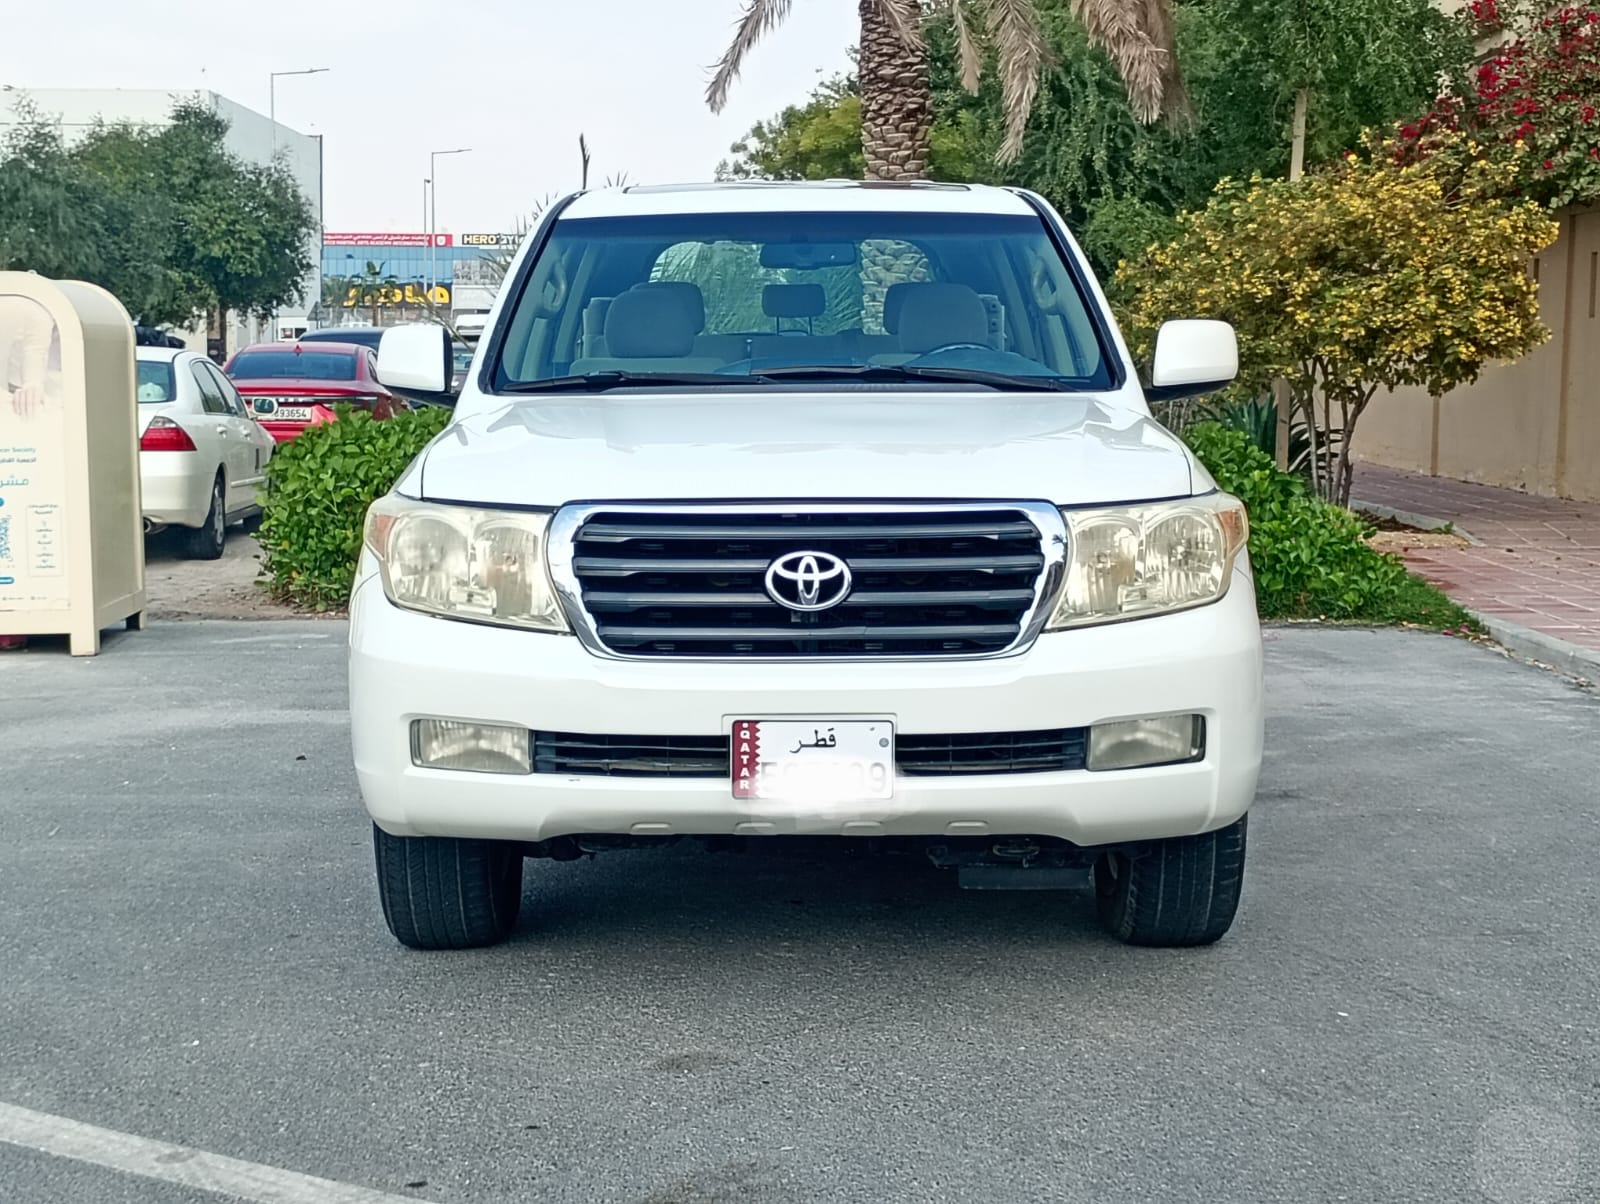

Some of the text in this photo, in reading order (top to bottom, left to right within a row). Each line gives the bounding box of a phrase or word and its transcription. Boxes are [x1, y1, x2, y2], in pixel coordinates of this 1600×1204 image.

[463, 234, 497, 244] HERO
[789, 727, 837, 754] قطر
[739, 729, 750, 790] QATAR
